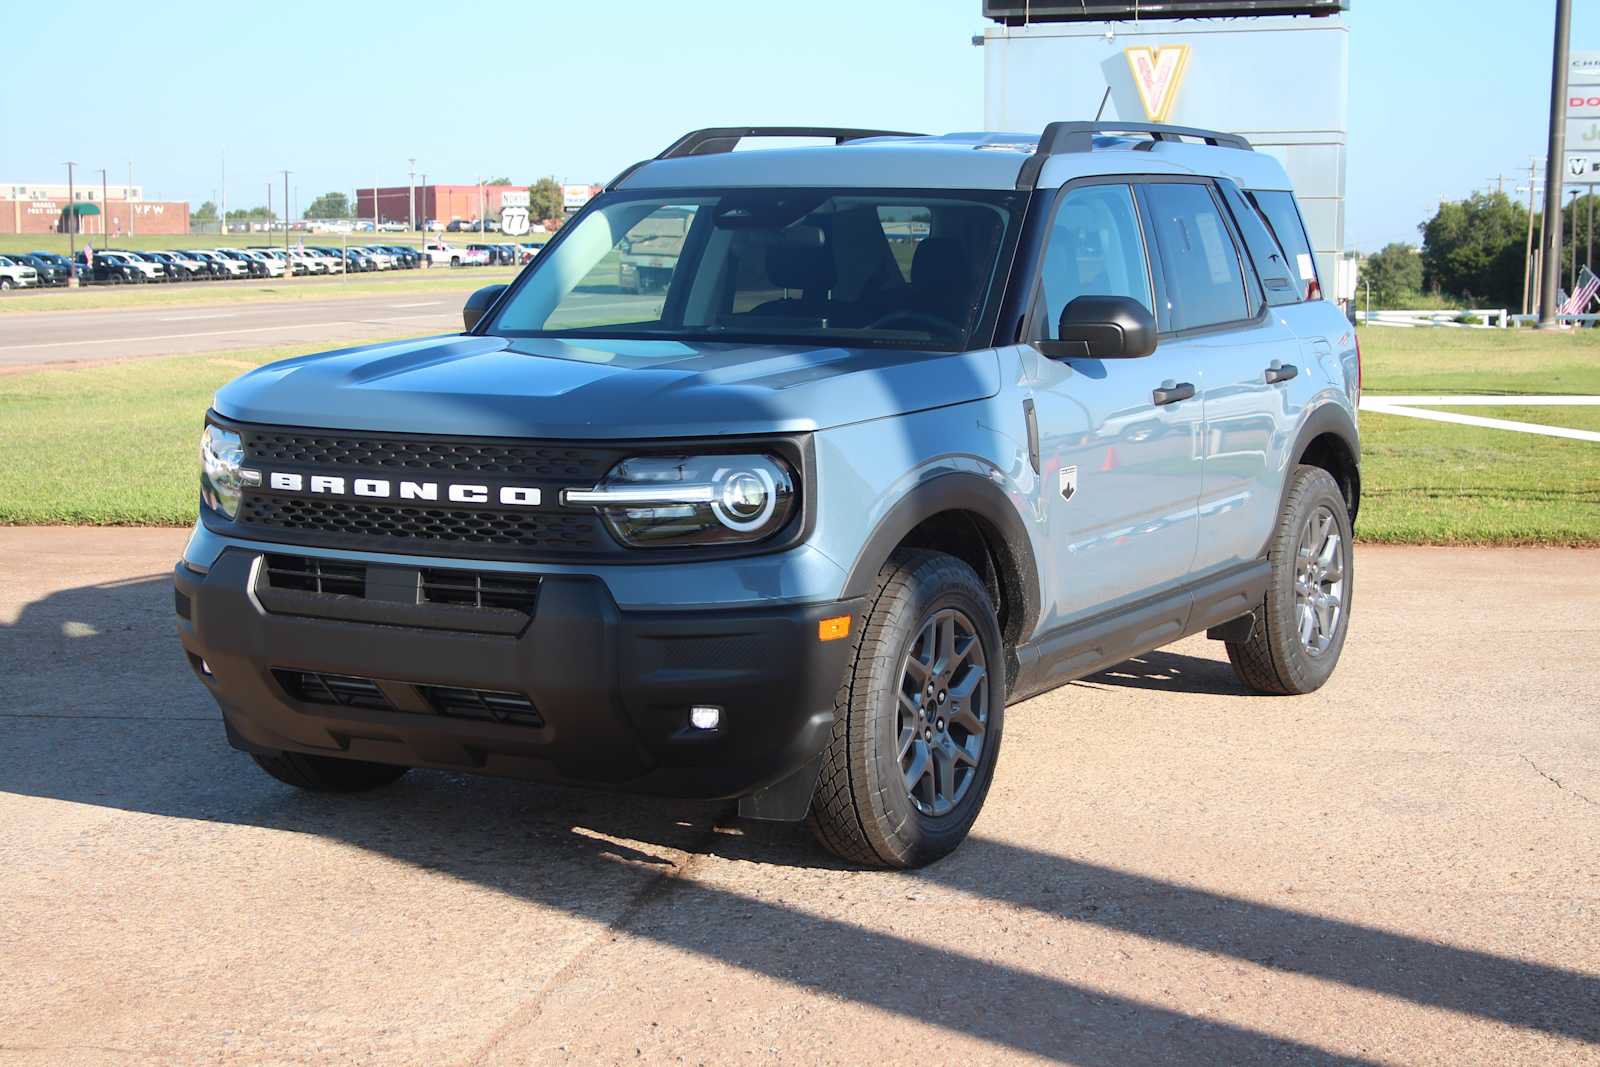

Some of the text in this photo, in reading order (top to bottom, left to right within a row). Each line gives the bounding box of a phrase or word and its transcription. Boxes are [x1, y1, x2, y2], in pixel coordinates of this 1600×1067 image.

[1124, 45, 1190, 122] V
[503, 193, 528, 203] NORTH
[505, 214, 526, 230] 77
[270, 472, 542, 506] BRONCO
